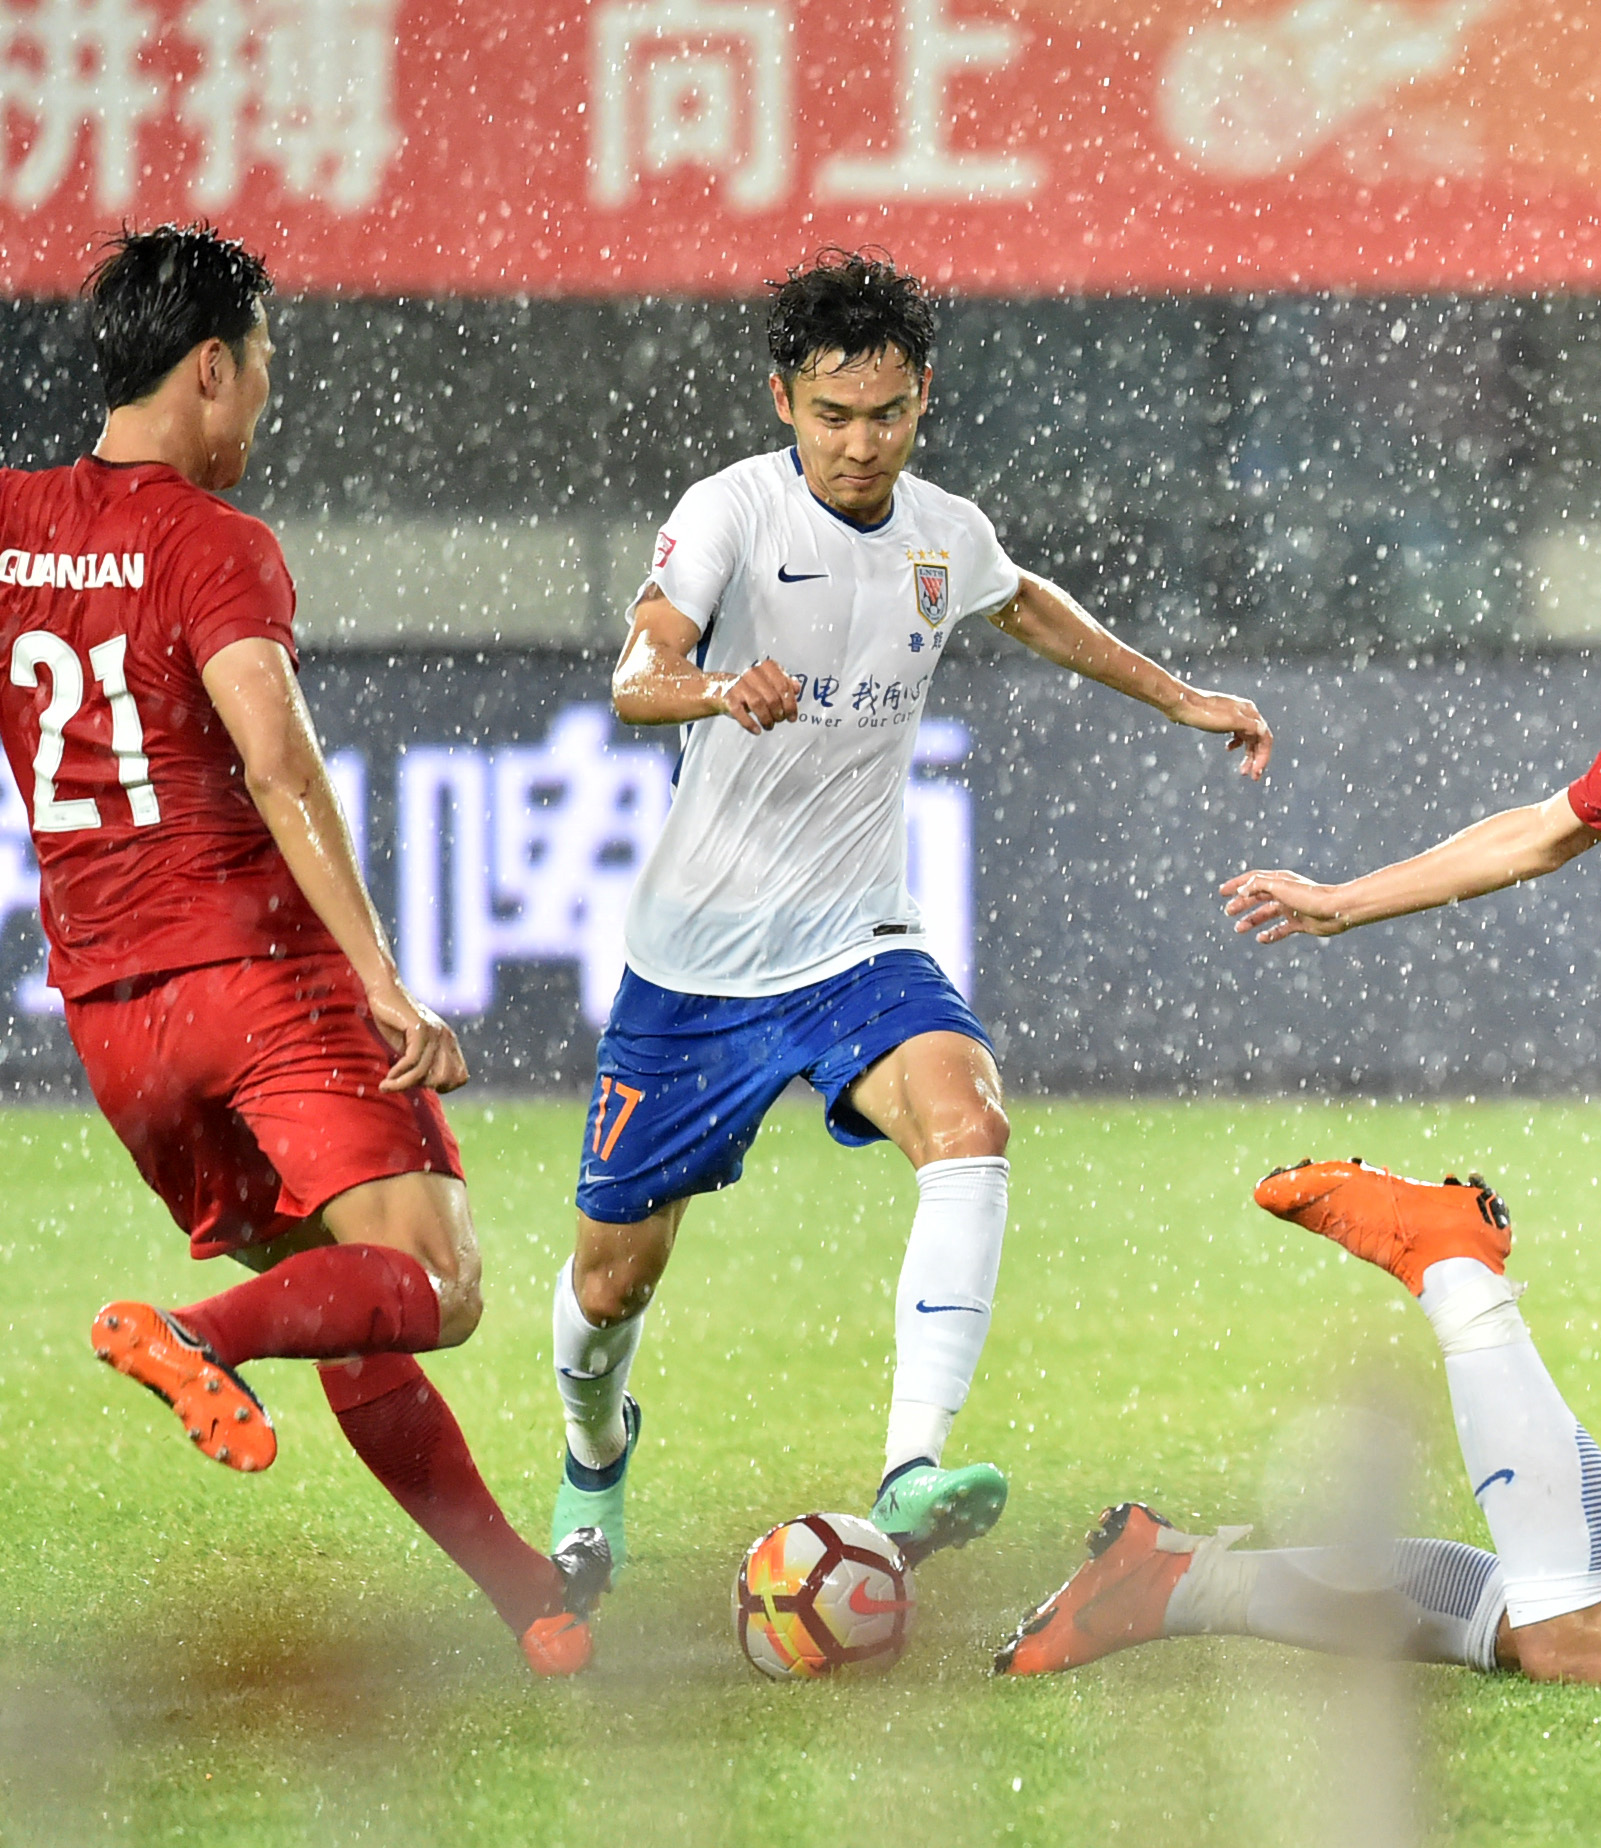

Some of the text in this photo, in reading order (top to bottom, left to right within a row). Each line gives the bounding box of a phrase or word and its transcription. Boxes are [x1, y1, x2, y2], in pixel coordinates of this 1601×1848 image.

[10, 629, 161, 832] 21
[798, 711, 843, 728] ower
[857, 716, 889, 729] Our
[591, 1076, 642, 1162] 17
